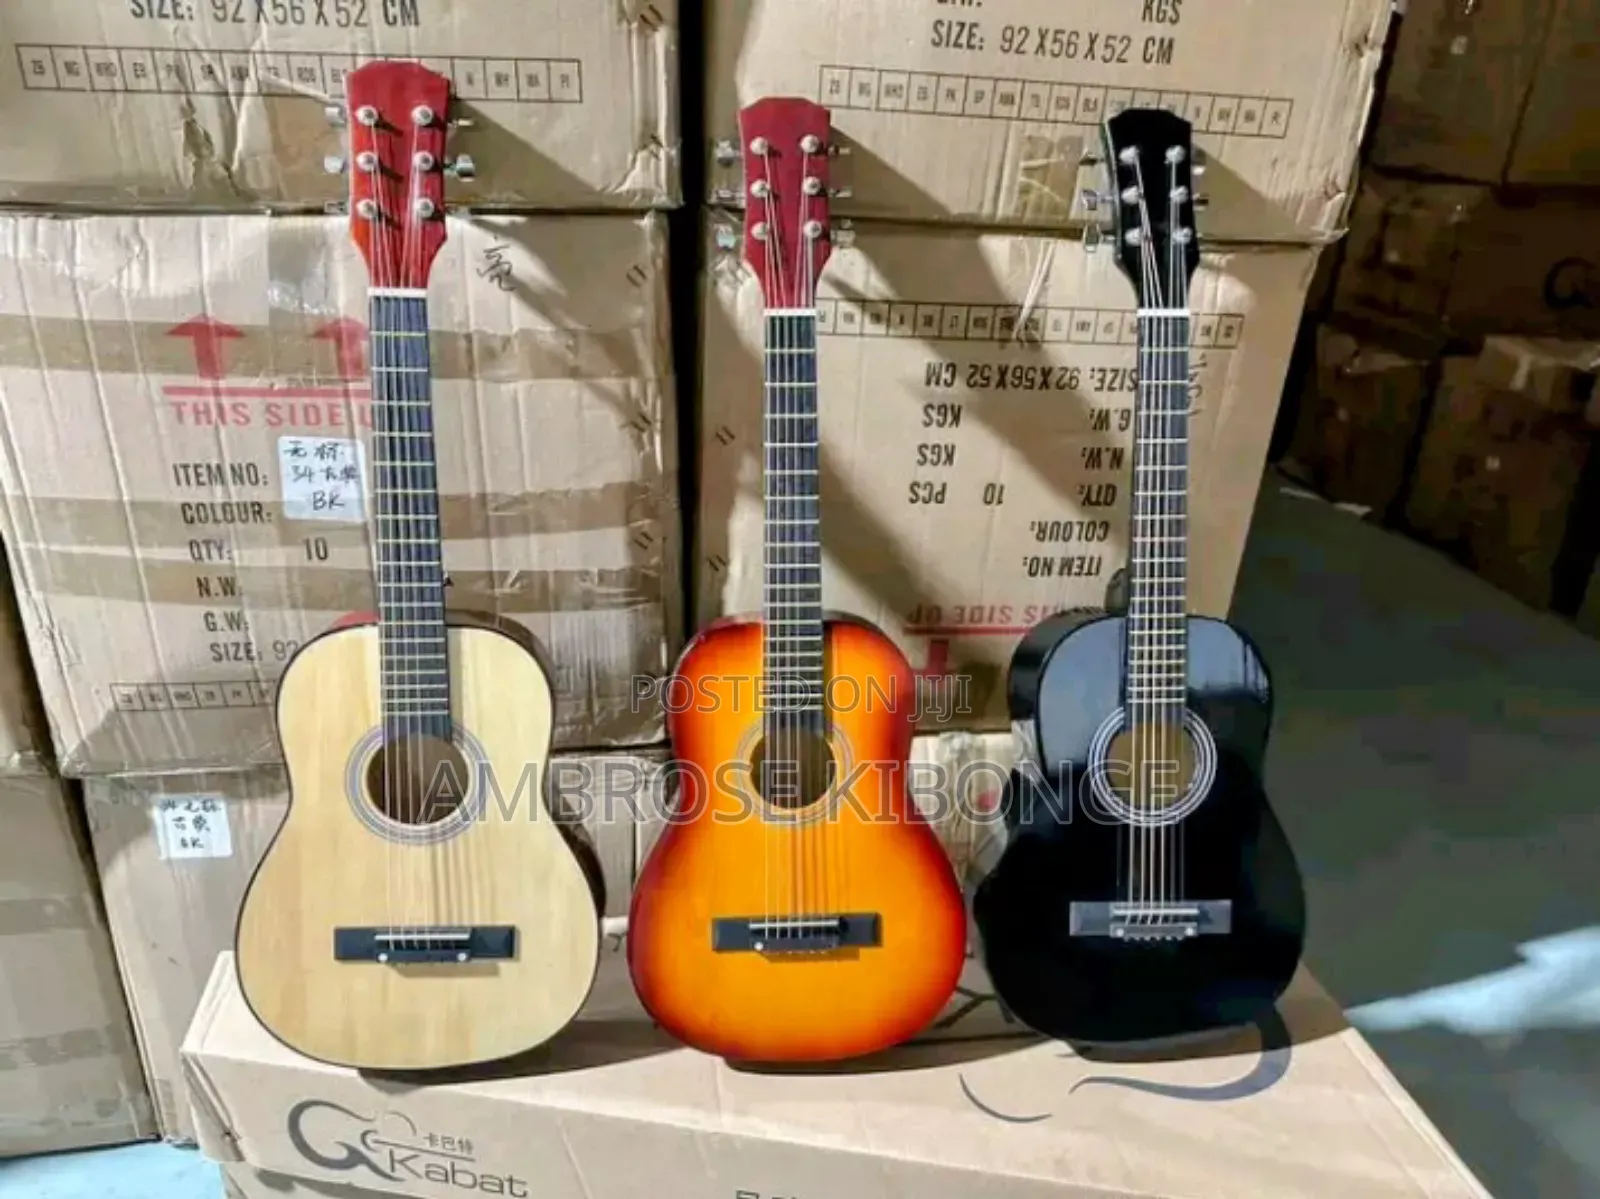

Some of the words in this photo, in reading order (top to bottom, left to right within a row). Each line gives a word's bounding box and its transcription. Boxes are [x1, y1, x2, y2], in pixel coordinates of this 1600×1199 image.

[131, 0, 193, 20] SIZE:
[382, 0, 420, 27] CM
[931, 19, 985, 50] SIZE:
[1142, 36, 1175, 65] CM
[925, 362, 957, 387] CM
[170, 401, 252, 427] THIS
[265, 402, 345, 428] SIDE
[922, 403, 962, 428] KGS
[1089, 408, 1132, 431] G.W:
[916, 443, 956, 466] KGS
[1080, 446, 1124, 470] N.W:
[172, 463, 229, 486] ITEM
[229, 463, 269, 486] NO:
[909, 481, 947, 504] PCS
[983, 482, 1005, 506] 10
[1078, 483, 1117, 507] QTY:
[181, 501, 273, 525] COLOUR:
[1029, 520, 1110, 542] COLOUR:
[188, 539, 232, 562] QTY:
[303, 537, 328, 561] 10
[1022, 556, 1053, 577] NO:
[1058, 556, 1102, 577] ITEM
[906, 604, 942, 625] UP
[955, 605, 1013, 624] SIDE
[389, 1149, 529, 1198] Kabat
